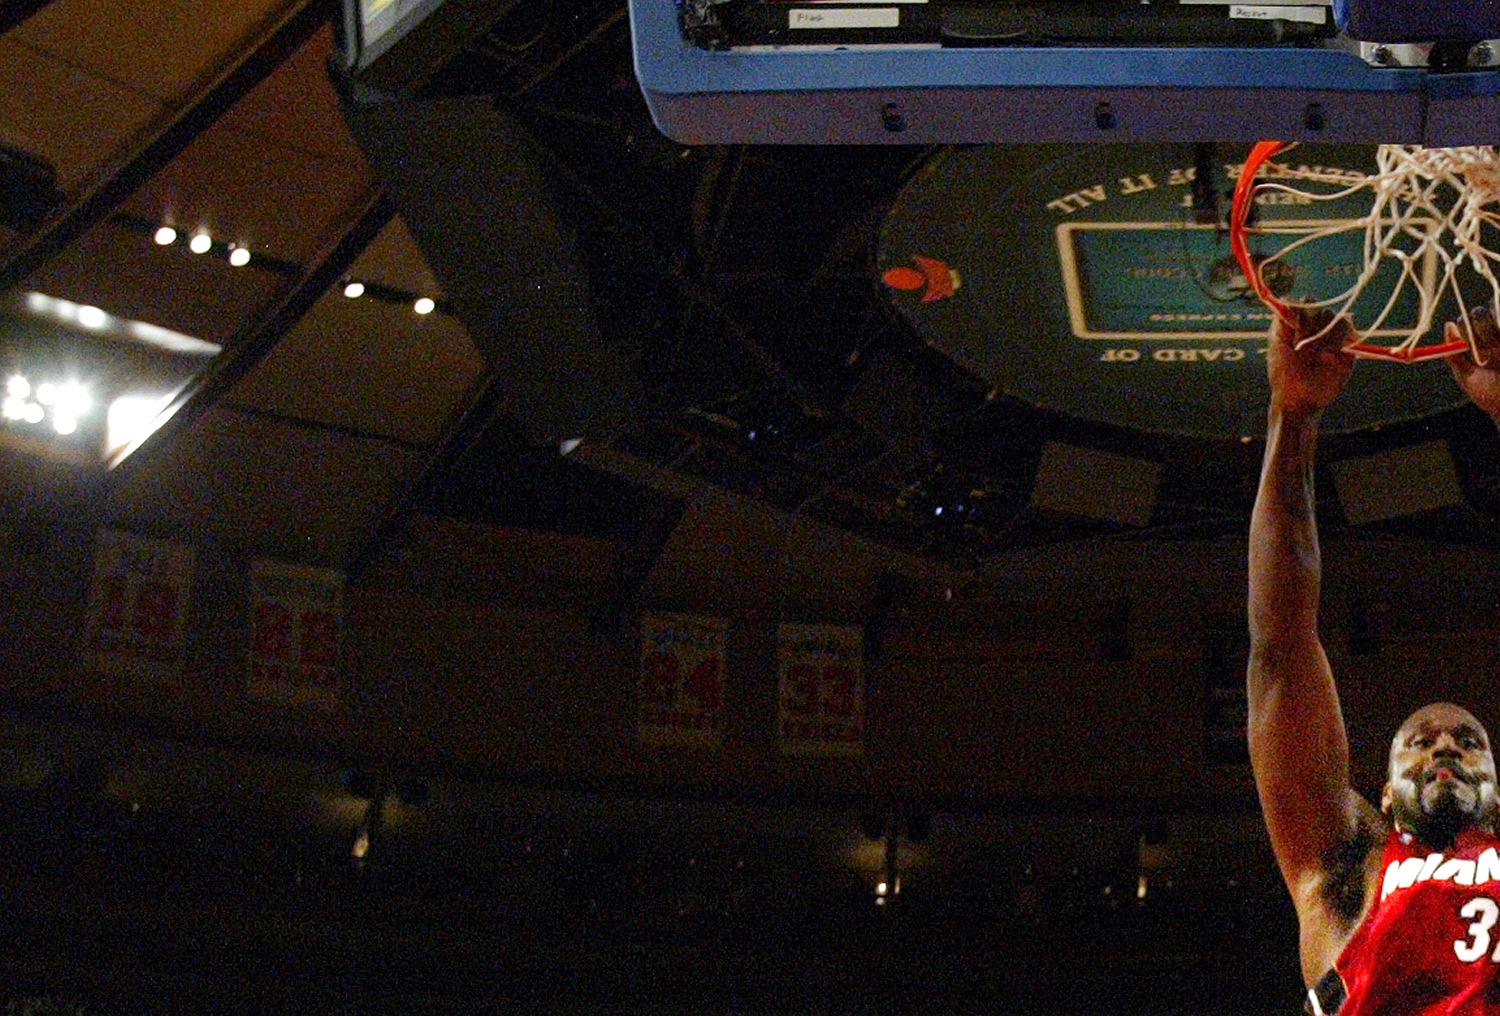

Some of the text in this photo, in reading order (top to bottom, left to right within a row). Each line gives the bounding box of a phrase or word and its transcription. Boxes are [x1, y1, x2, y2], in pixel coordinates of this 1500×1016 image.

[1120, 174, 1156, 195] IT
[1046, 185, 1107, 213] ALL
[1099, 348, 1141, 363] OF
[1152, 347, 1246, 362] CARD
